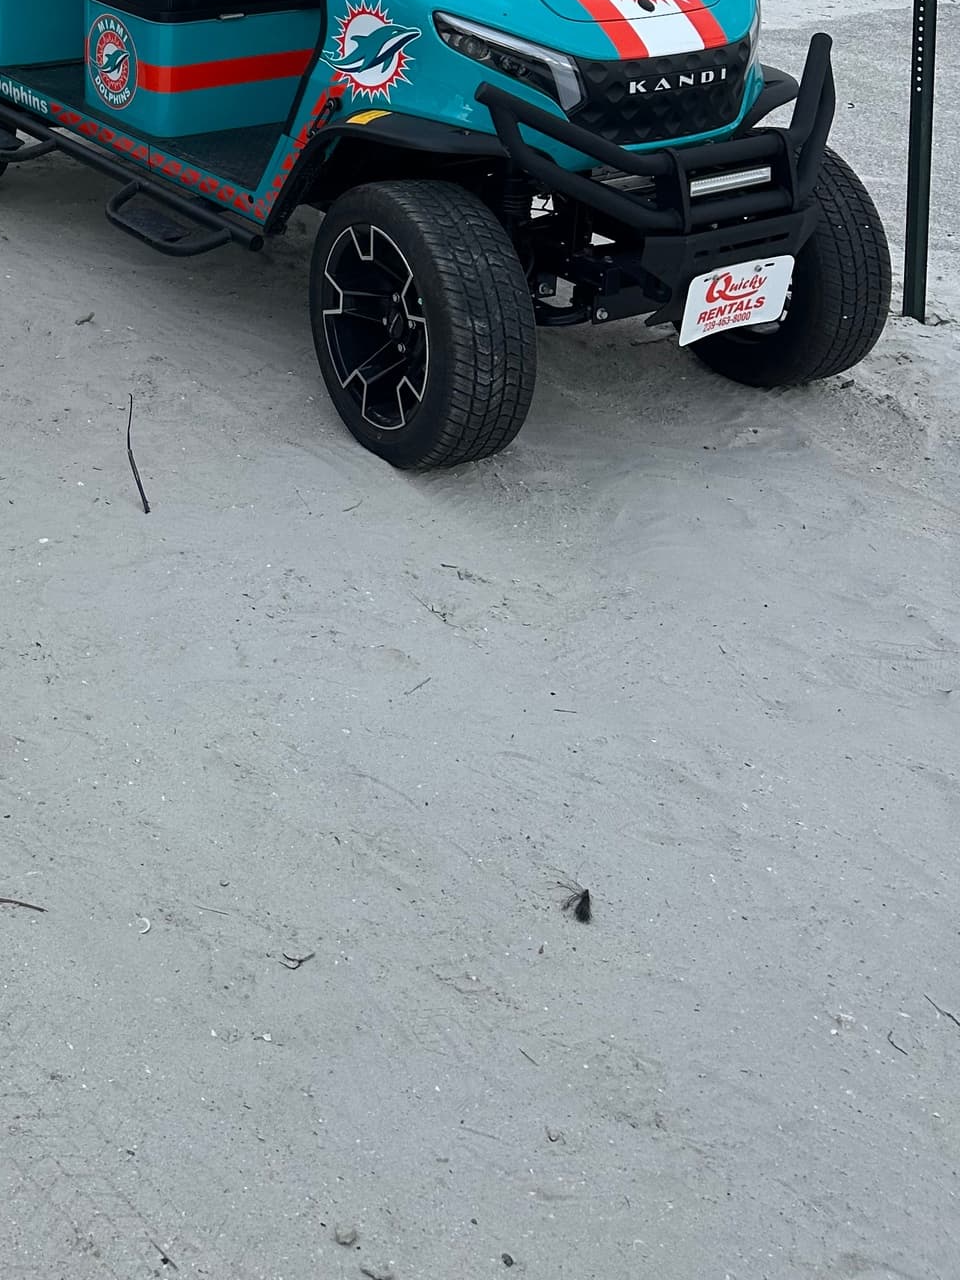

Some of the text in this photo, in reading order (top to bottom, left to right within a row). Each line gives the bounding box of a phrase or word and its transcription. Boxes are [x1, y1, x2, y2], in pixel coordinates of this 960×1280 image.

[97, 18, 128, 43] MIAMI
[94, 75, 131, 105] DOLPHINS
[628, 67, 727, 95] KANDI
[696, 296, 766, 325] RENTALS
